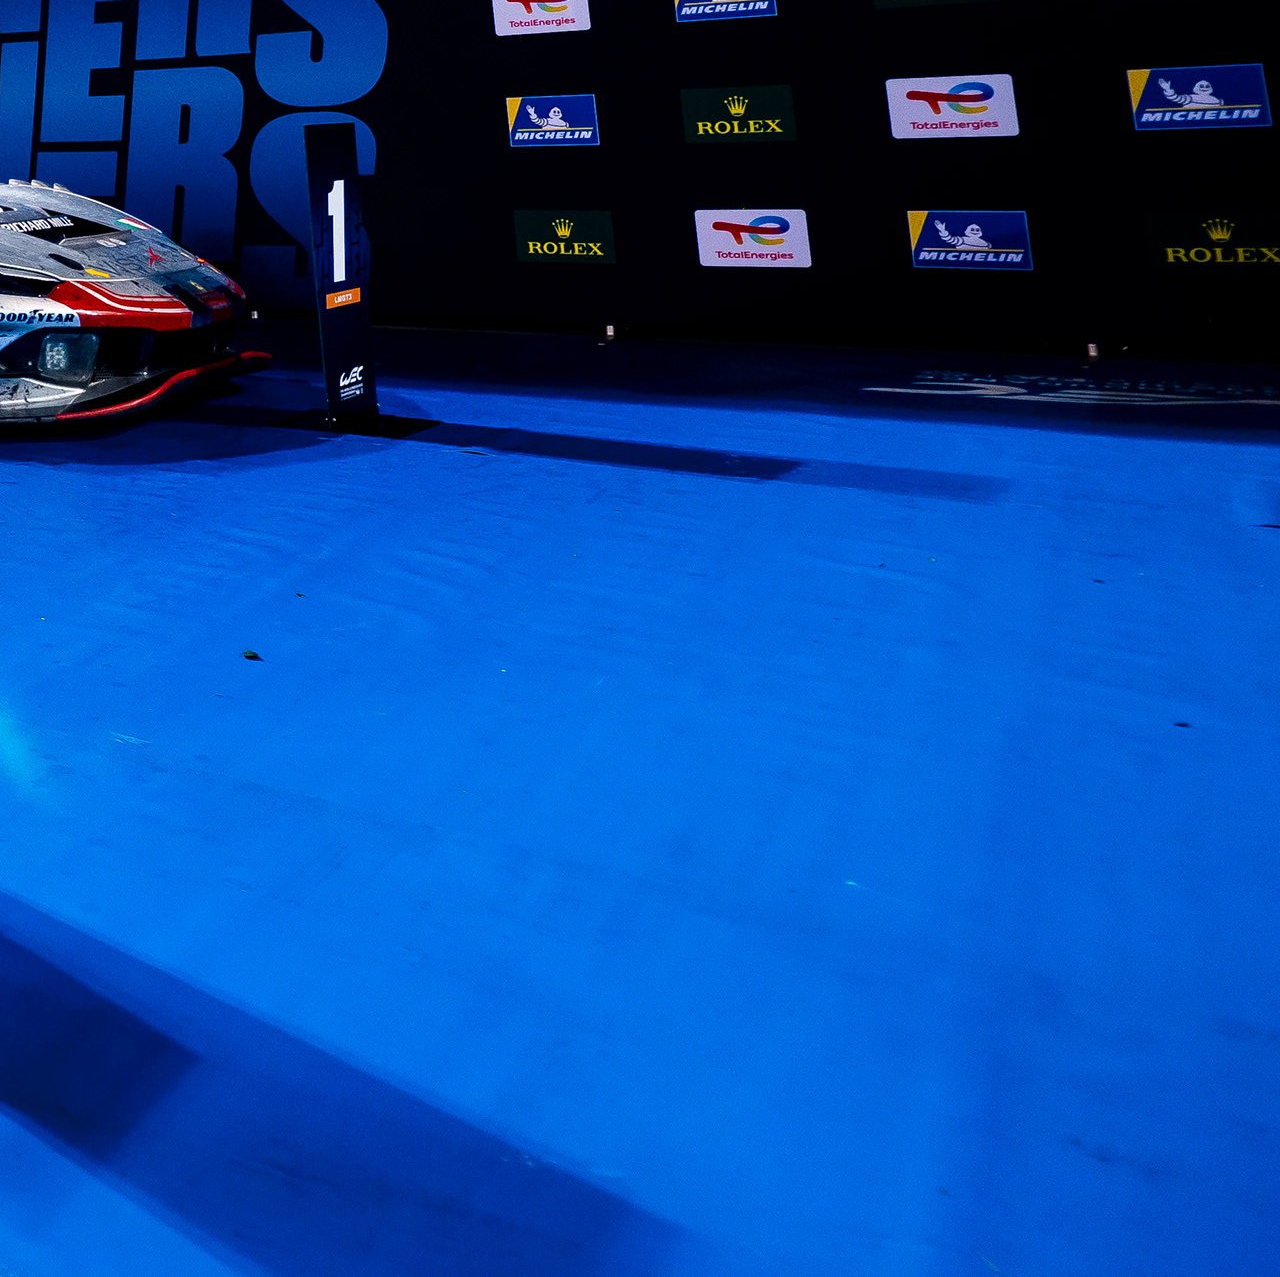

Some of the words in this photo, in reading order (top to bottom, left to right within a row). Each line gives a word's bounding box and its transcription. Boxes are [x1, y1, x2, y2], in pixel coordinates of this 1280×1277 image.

[680, 0, 770, 16] MICHELIN
[508, 15, 576, 30] TotalEnergies
[1140, 107, 1261, 123] MICHELIN
[696, 119, 784, 136] ROLEX
[909, 118, 1000, 132] TotalEnergies
[514, 130, 593, 141] MICHELIN
[0, 219, 51, 233] RICHARD
[51, 216, 75, 228] MILLE
[327, 179, 346, 283] 1
[527, 241, 604, 257] ROLEX
[715, 249, 795, 262] TotalEnergies
[1165, 246, 1280, 264] ROLEX
[918, 251, 1024, 264] MICHELIN
[339, 365, 364, 387] WEC
